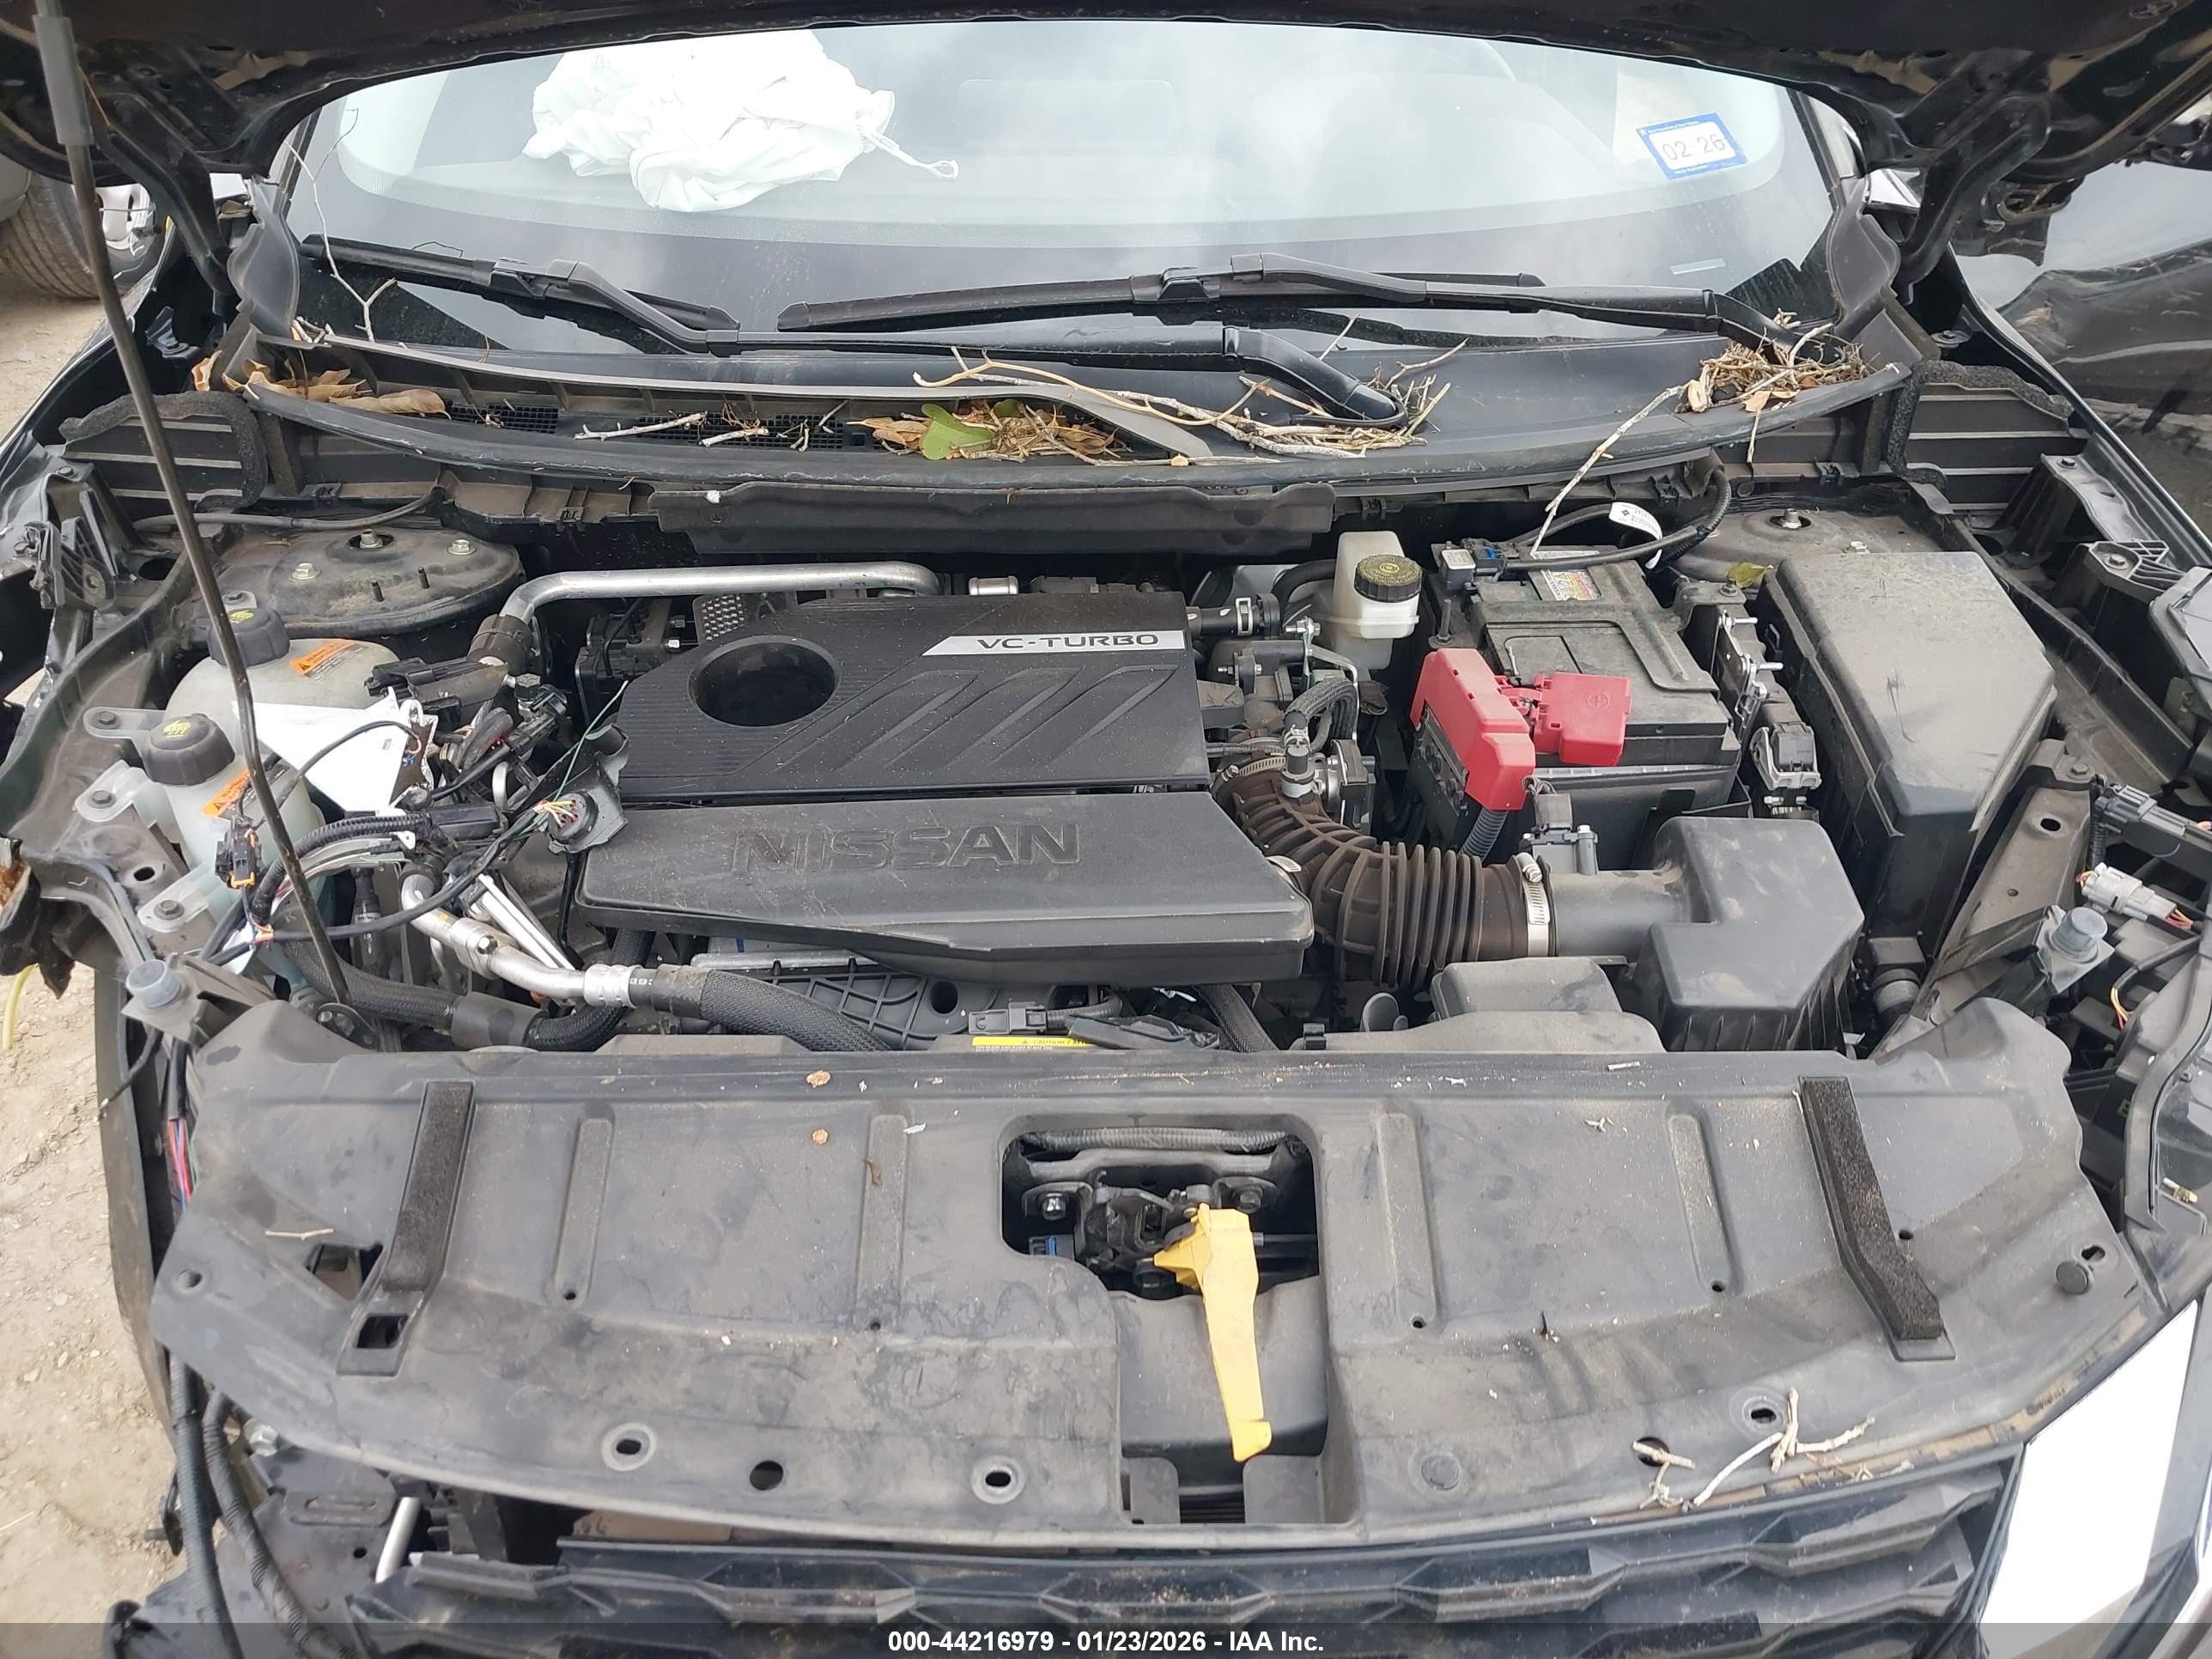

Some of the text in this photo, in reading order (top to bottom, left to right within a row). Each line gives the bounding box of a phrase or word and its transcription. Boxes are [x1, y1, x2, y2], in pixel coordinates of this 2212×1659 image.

[1662, 134, 1725, 161] 02 26
[977, 634, 1159, 649] VC-TURBO
[732, 823, 1080, 870] NISSAN
